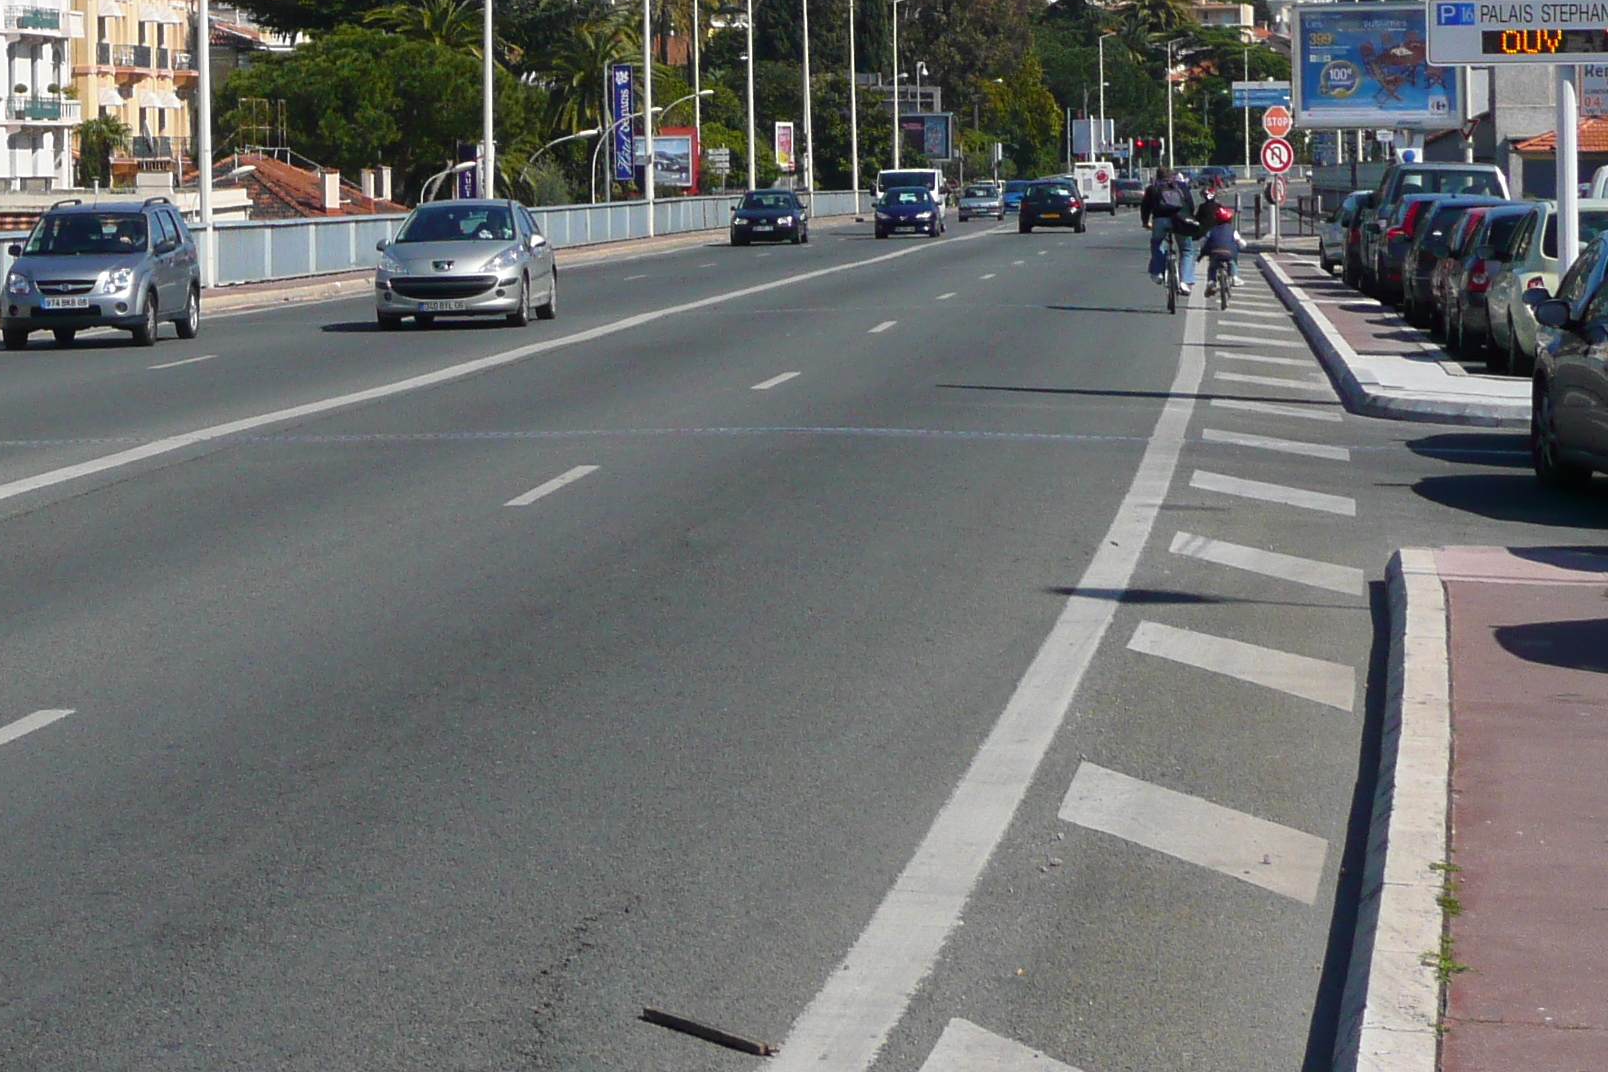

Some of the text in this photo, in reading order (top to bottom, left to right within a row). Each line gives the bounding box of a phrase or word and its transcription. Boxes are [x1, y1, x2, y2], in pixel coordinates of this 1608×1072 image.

[1440, 5, 1456, 24] P
[1480, 4, 1533, 23] PALAIS
[1266, 117, 1289, 127] STOP
